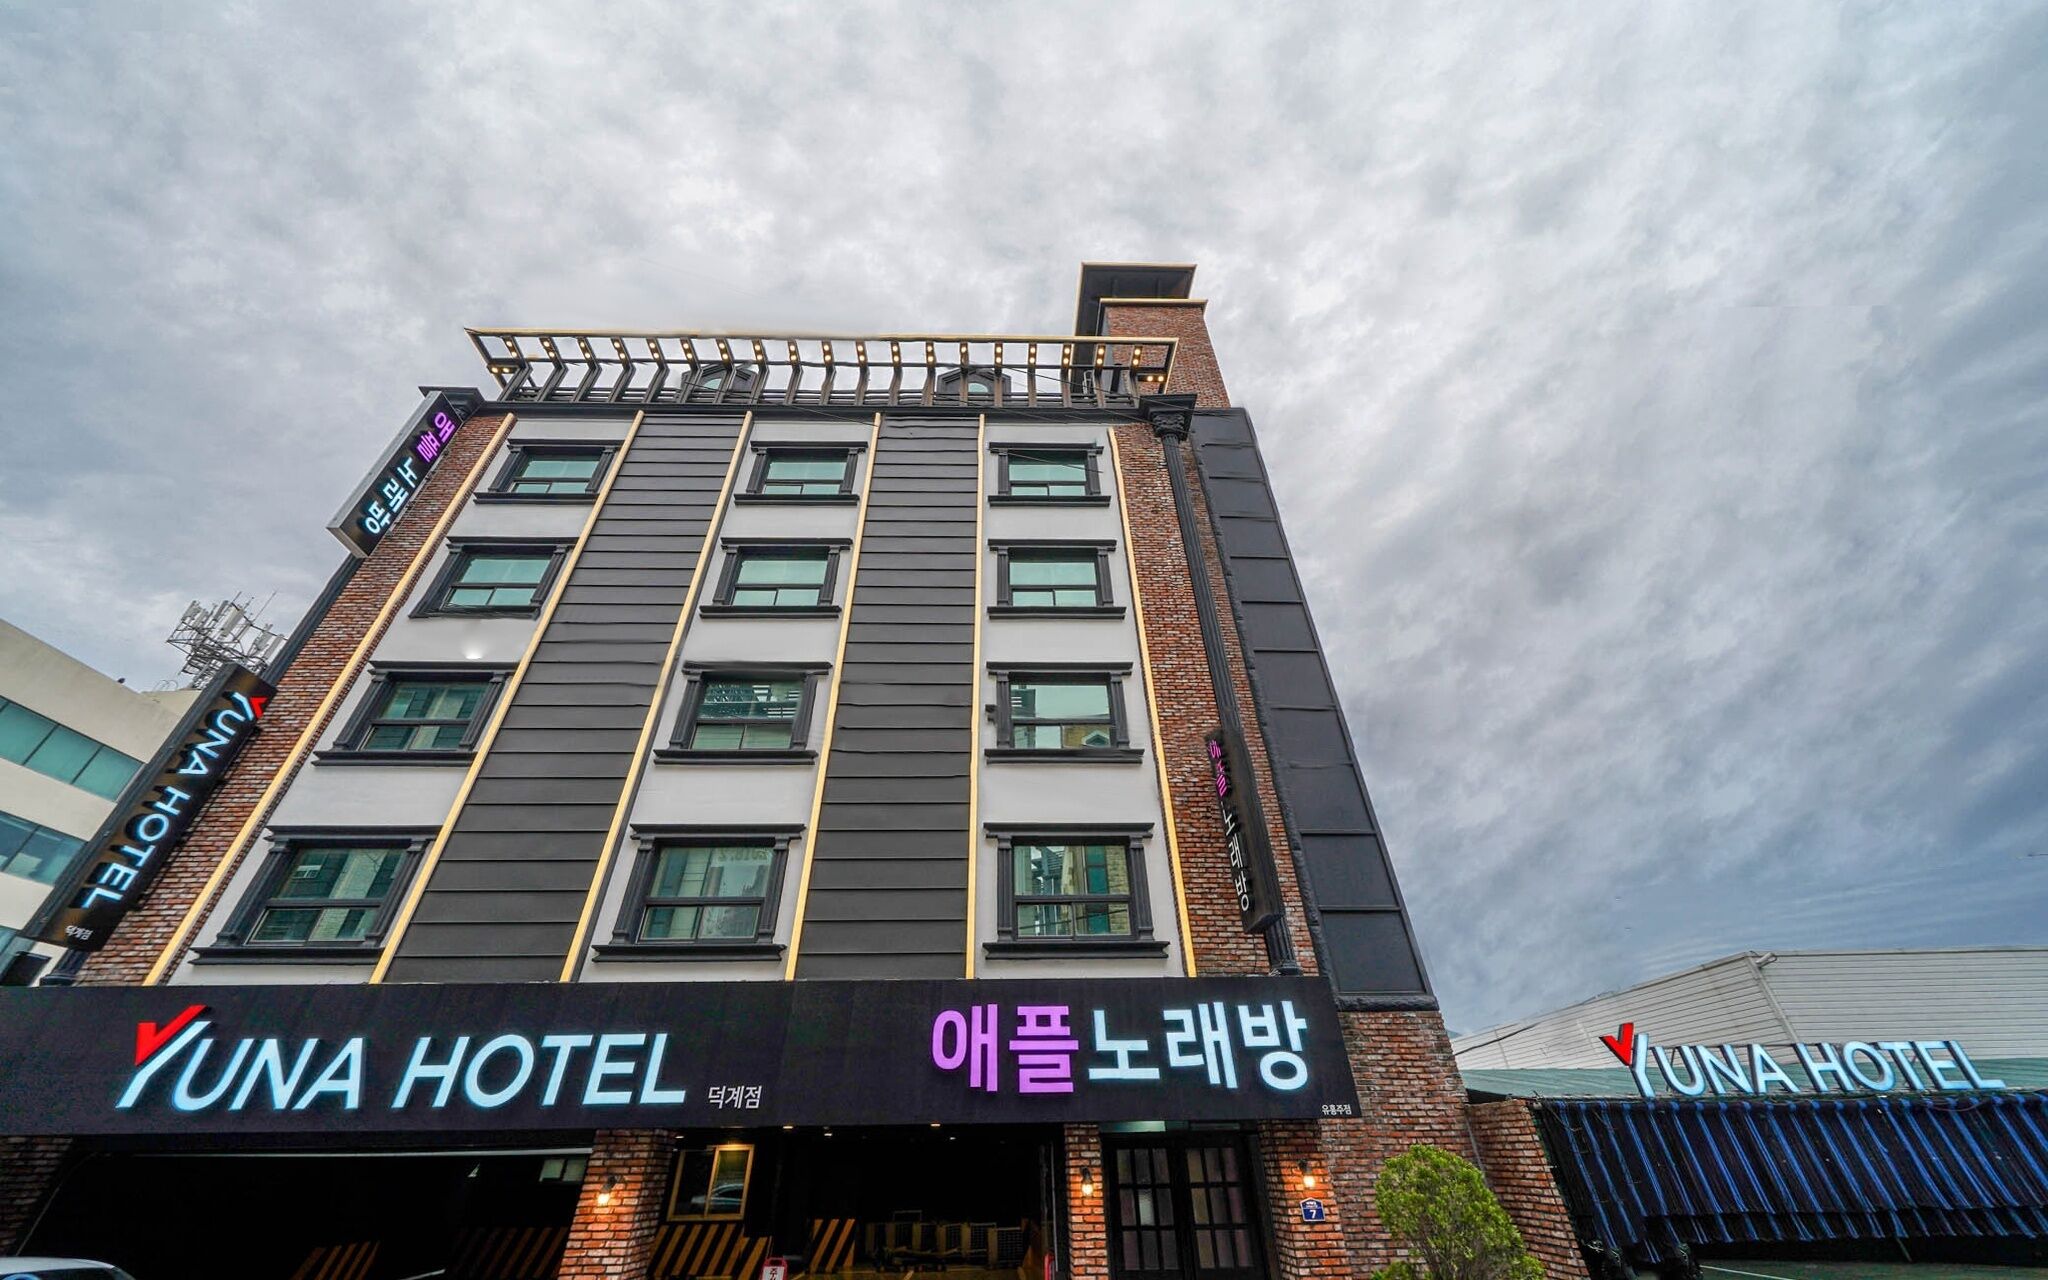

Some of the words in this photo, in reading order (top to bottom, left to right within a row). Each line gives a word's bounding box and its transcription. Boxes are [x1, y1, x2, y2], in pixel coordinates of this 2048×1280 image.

[177, 691, 268, 776] YUNA
[82, 785, 192, 910] HOTEL
[116, 1004, 363, 1110] YUNA
[392, 1034, 686, 1107] HOTEL
[932, 1001, 1308, 1093] 애플노래방
[1600, 1022, 1801, 1098] YUNA
[1794, 1040, 2007, 1091] HOTEL
[708, 1085, 763, 1109] 덕계점
[1321, 1104, 1353, 1116] 유흥주점
[1309, 1209, 1317, 1219] 7
